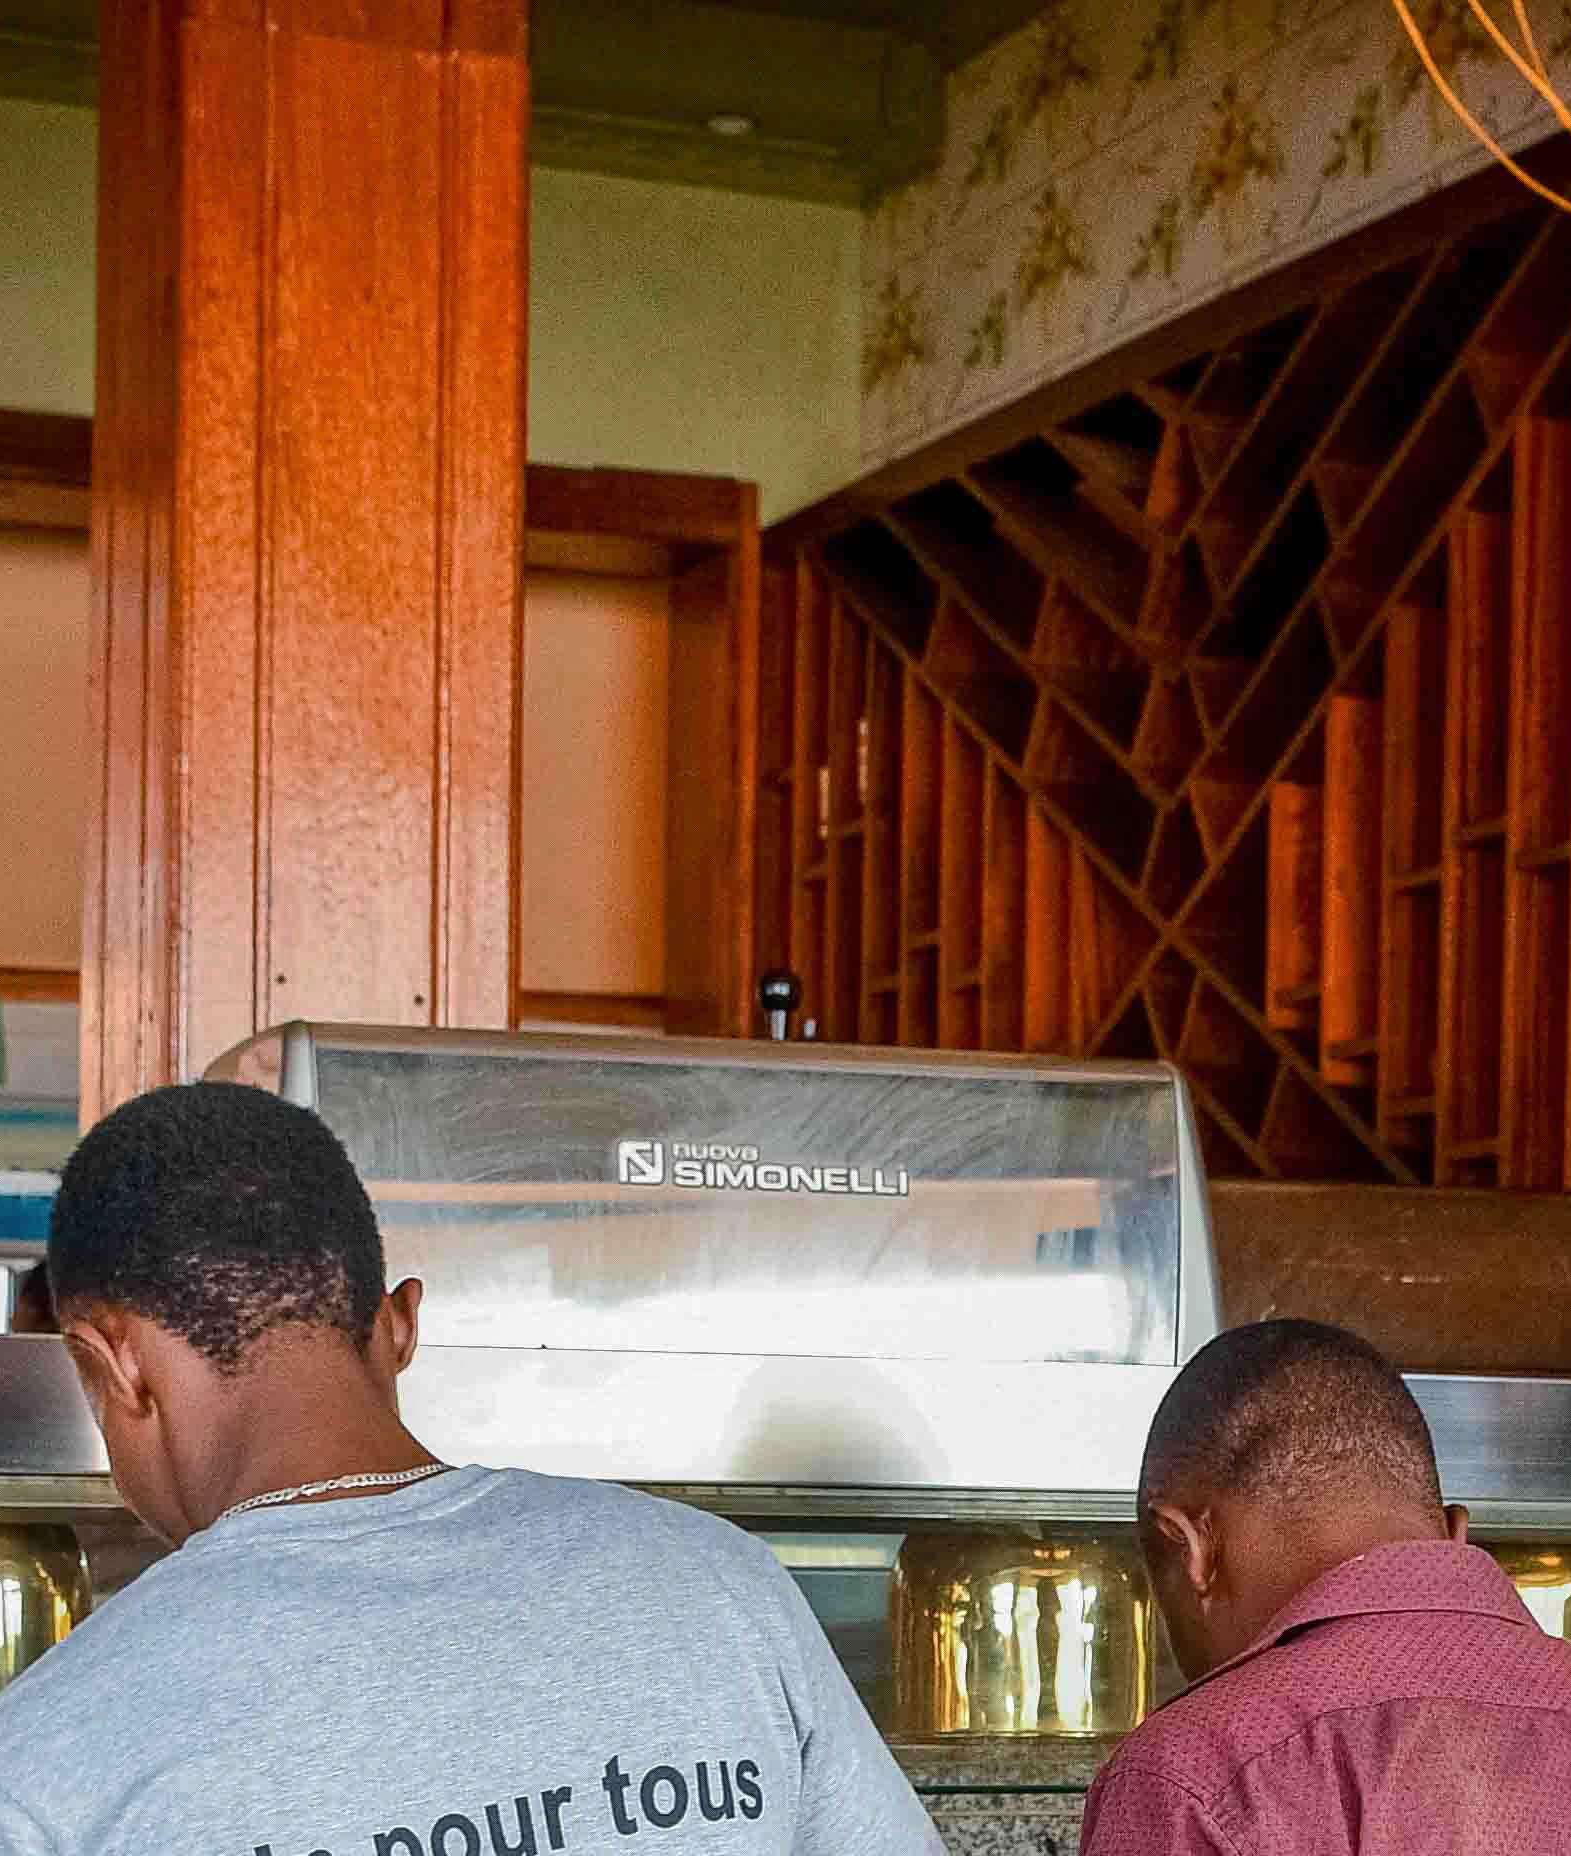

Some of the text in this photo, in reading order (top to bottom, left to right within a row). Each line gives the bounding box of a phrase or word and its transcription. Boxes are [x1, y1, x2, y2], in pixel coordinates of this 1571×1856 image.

[673, 1143, 759, 1161] nuova
[674, 1160, 908, 1195] SIMONELLI
[601, 1754, 763, 1836] tous
